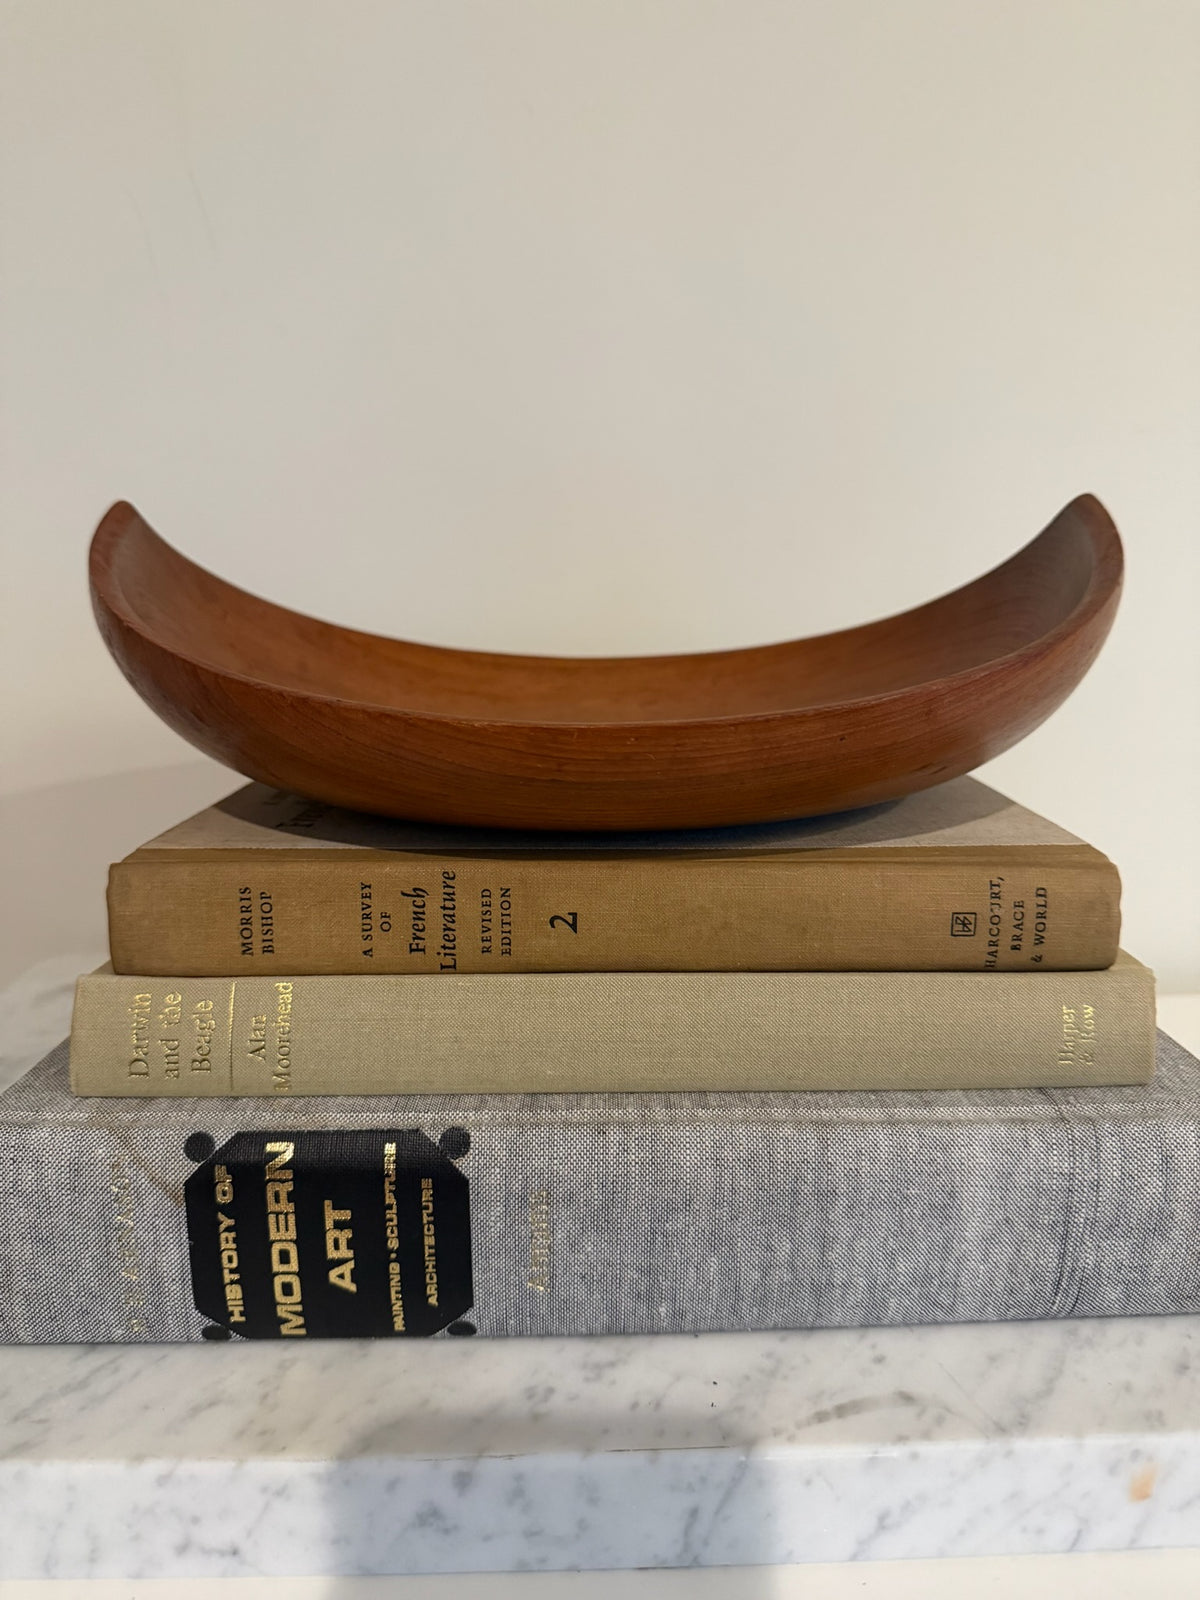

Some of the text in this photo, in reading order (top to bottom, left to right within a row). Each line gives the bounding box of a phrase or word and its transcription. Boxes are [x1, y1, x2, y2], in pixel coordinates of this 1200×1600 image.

[239, 886, 254, 956] MORRIS
[260, 891, 275, 954] BISHOP
[361, 882, 373, 958] A SURVEY
[380, 911, 392, 932] OF
[401, 887, 429, 955] French
[437, 870, 457, 971] Literature
[481, 888, 492, 954] REVISED
[500, 887, 512, 956] EDITION
[549, 912, 578, 934] 2
[1010, 900, 1025, 951] BRACE
[1034, 887, 1048, 946] WORLD
[128, 993, 152, 1078] Darwin
[159, 991, 182, 1079] and the
[191, 999, 216, 1073] Beagle
[248, 1014, 267, 1062] Alan
[272, 981, 293, 1092] Moorehead
[214, 1164, 246, 1323] HISTORY OF
[265, 1141, 307, 1336] MODERN
[324, 1200, 357, 1293] ART
[383, 1142, 405, 1332] PAINTING SCULPTURE
[421, 1177, 438, 1307] ARCHITECTURE
